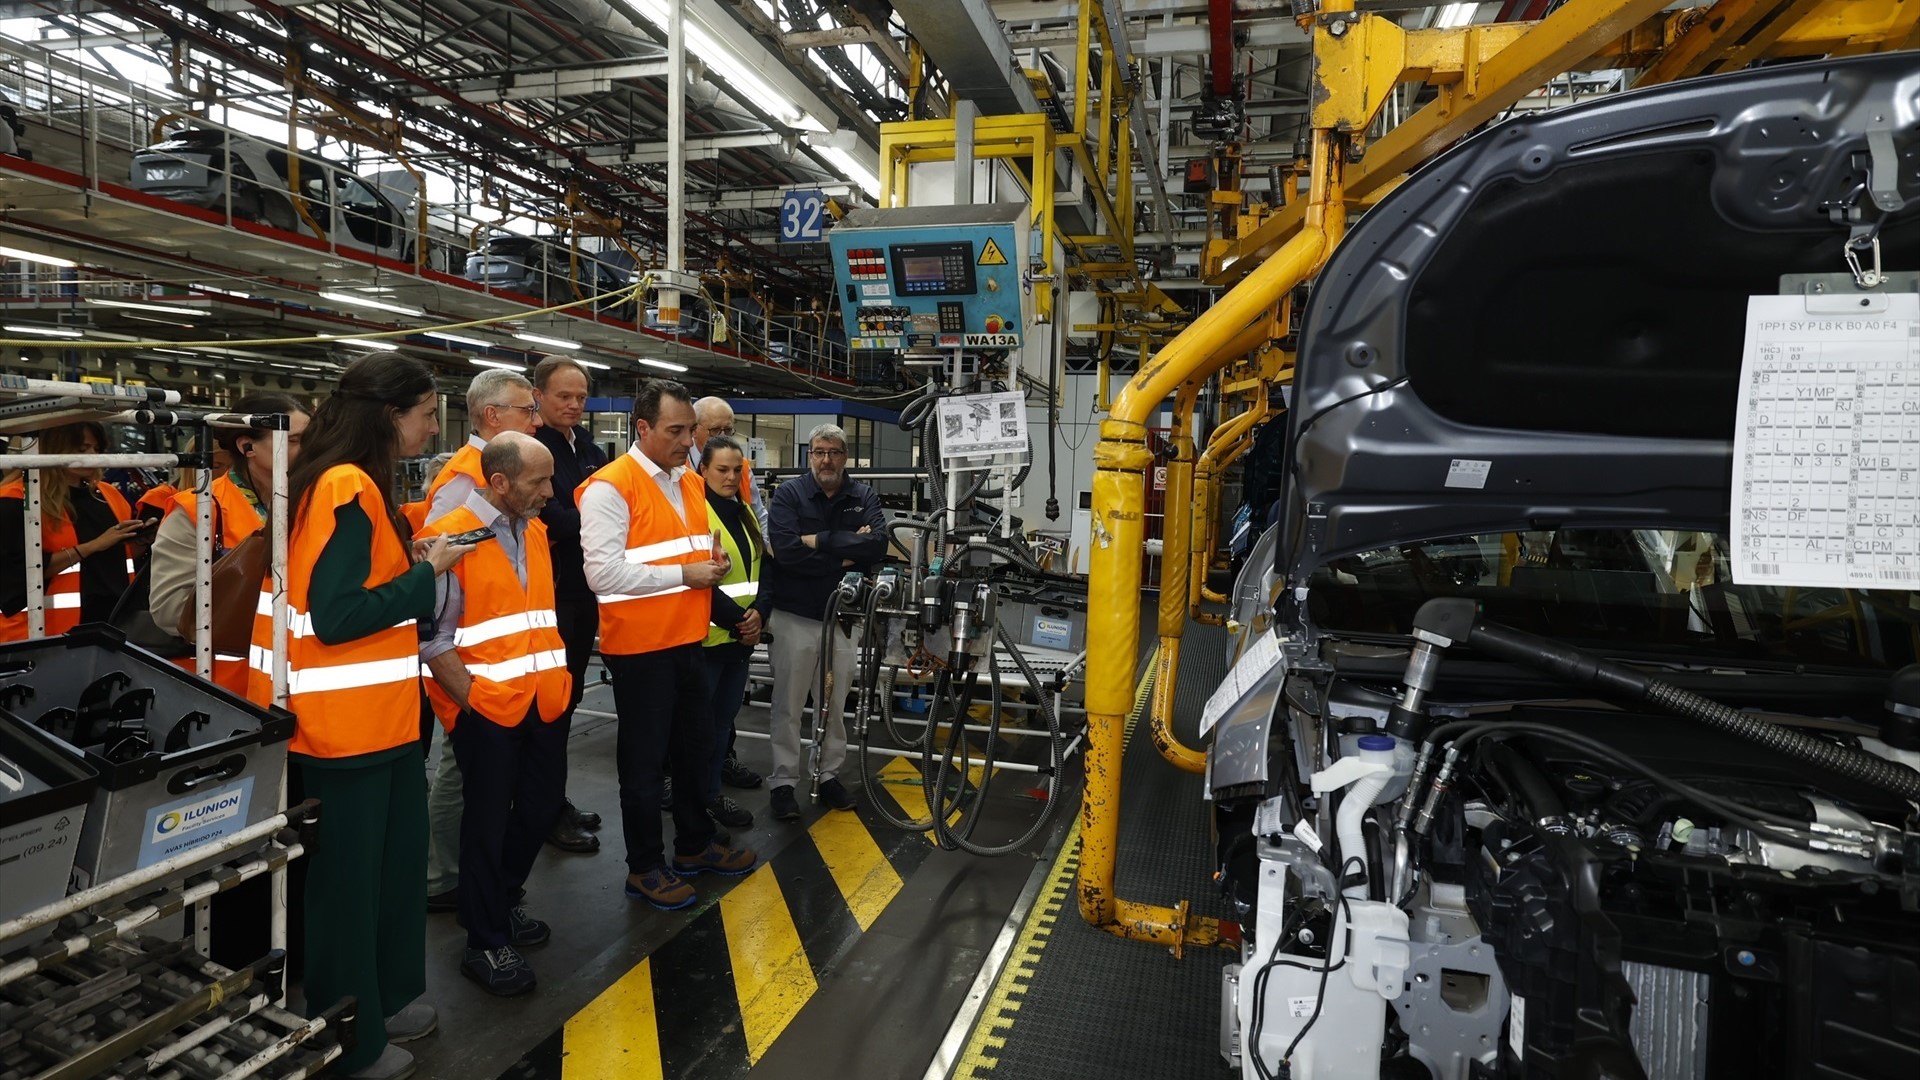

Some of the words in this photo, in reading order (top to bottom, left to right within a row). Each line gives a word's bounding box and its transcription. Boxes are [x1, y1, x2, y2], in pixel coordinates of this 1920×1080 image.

[783, 197, 822, 238] 32
[1760, 322, 1786, 331] 1PP1
[1789, 322, 1805, 331] SY
[1808, 322, 1816, 330] P
[1818, 322, 1832, 330] L8
[1835, 322, 1843, 330] K
[1883, 321, 1897, 330] F4
[966, 336, 1017, 345] WA13A
[1762, 374, 1770, 383] B
[1891, 373, 1899, 382] F
[1836, 402, 1852, 411] RJ
[1760, 415, 1769, 424] D
[1818, 416, 1828, 424] M
[1776, 442, 1783, 452] L
[1816, 442, 1826, 452] C
[1794, 457, 1803, 466] N
[1814, 457, 1822, 466] 3
[1834, 458, 1842, 467] 5
[1881, 458, 1890, 467] B
[1900, 472, 1909, 481] B
[1792, 498, 1800, 507] 2
[1750, 510, 1767, 520] NS
[1788, 511, 1806, 521] DF
[1860, 513, 1868, 522] P
[1874, 513, 1892, 523] ST
[1752, 524, 1760, 533] K
[1878, 528, 1887, 537] C
[1897, 528, 1904, 537] 3
[1753, 538, 1761, 547] B
[1806, 540, 1822, 549] AL
[1752, 552, 1760, 560] K
[1770, 552, 1779, 560] T
[1826, 553, 1842, 563] FT
[1896, 556, 1905, 565] N
[184, 796, 239, 821] ILUNION
[24, 835, 67, 858] (09.24)
[164, 843, 182, 855] AVAS
